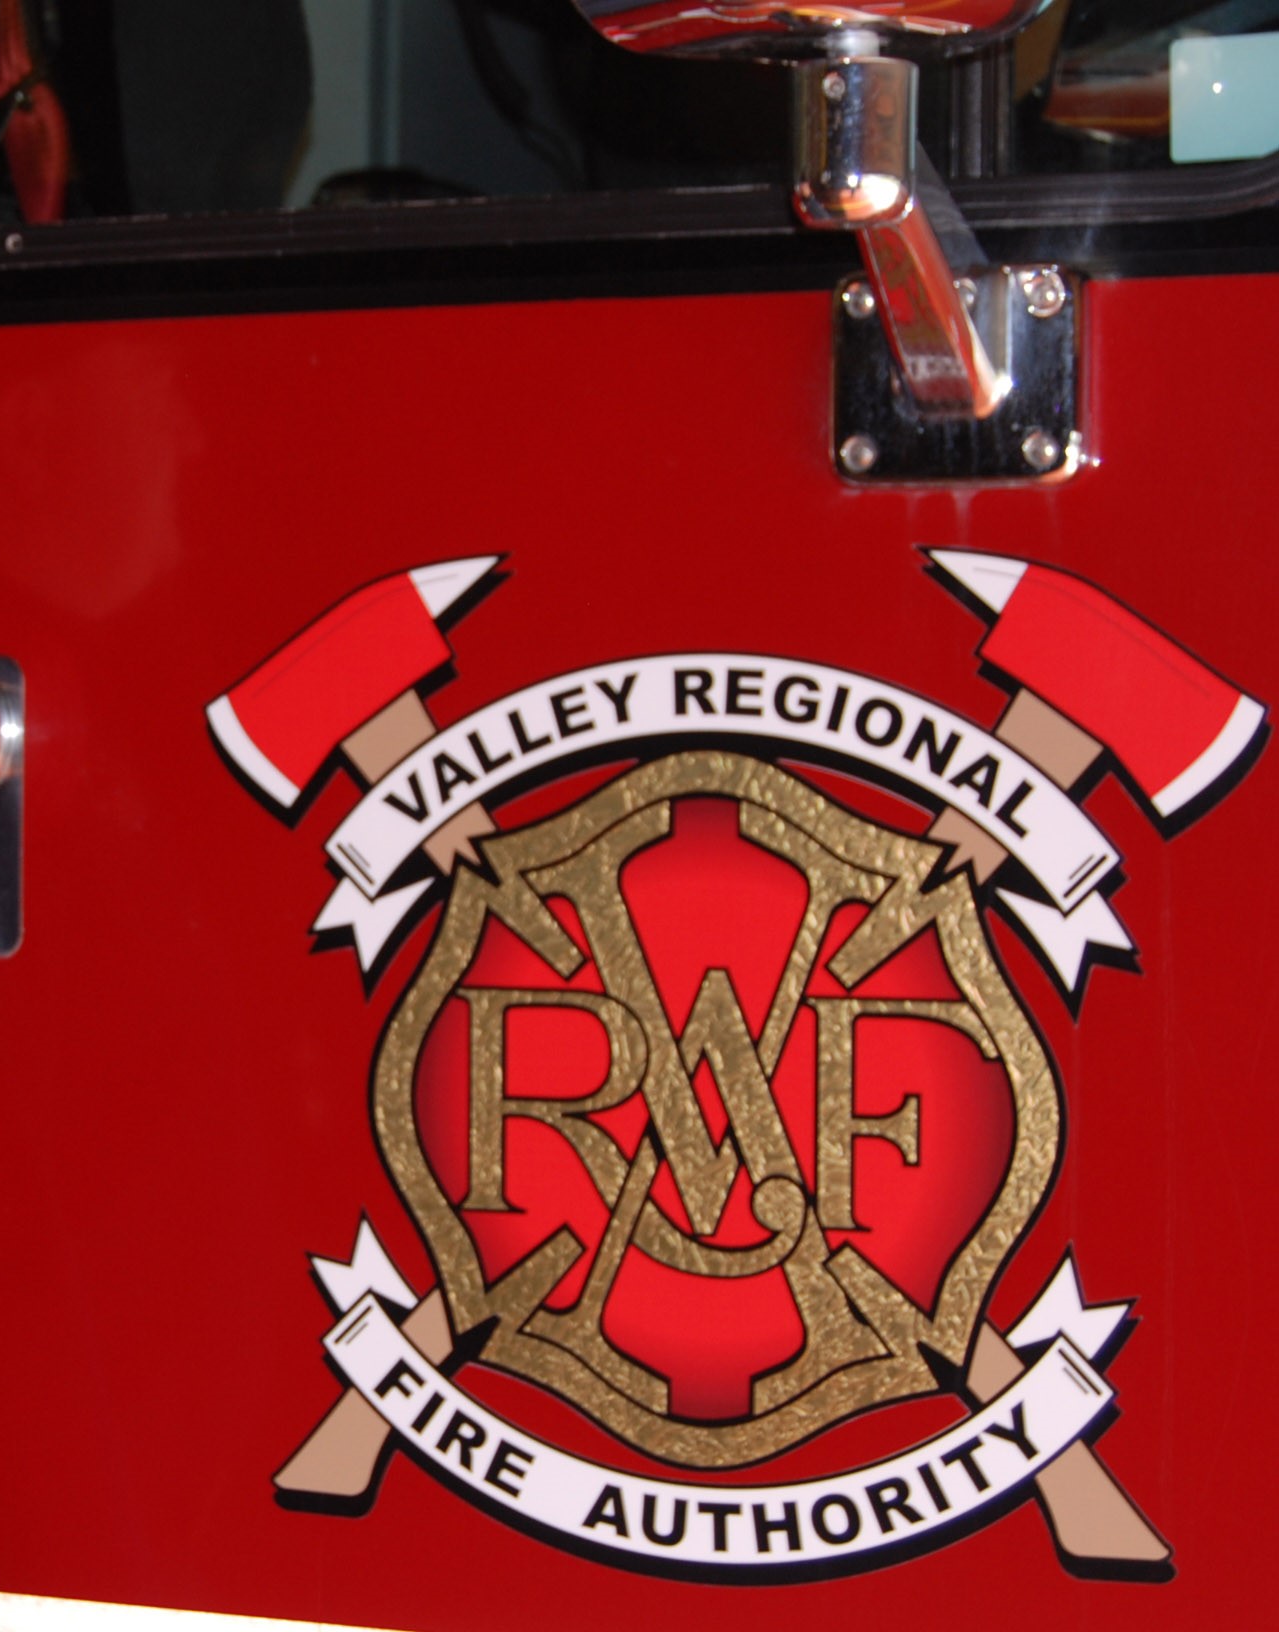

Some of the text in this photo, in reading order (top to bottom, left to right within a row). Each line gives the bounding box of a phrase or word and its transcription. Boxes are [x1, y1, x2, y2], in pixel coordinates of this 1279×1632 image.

[383, 668, 1033, 839] VALLEY REGIONAL
[373, 1358, 1040, 1554] FIRE AUTHORITY
